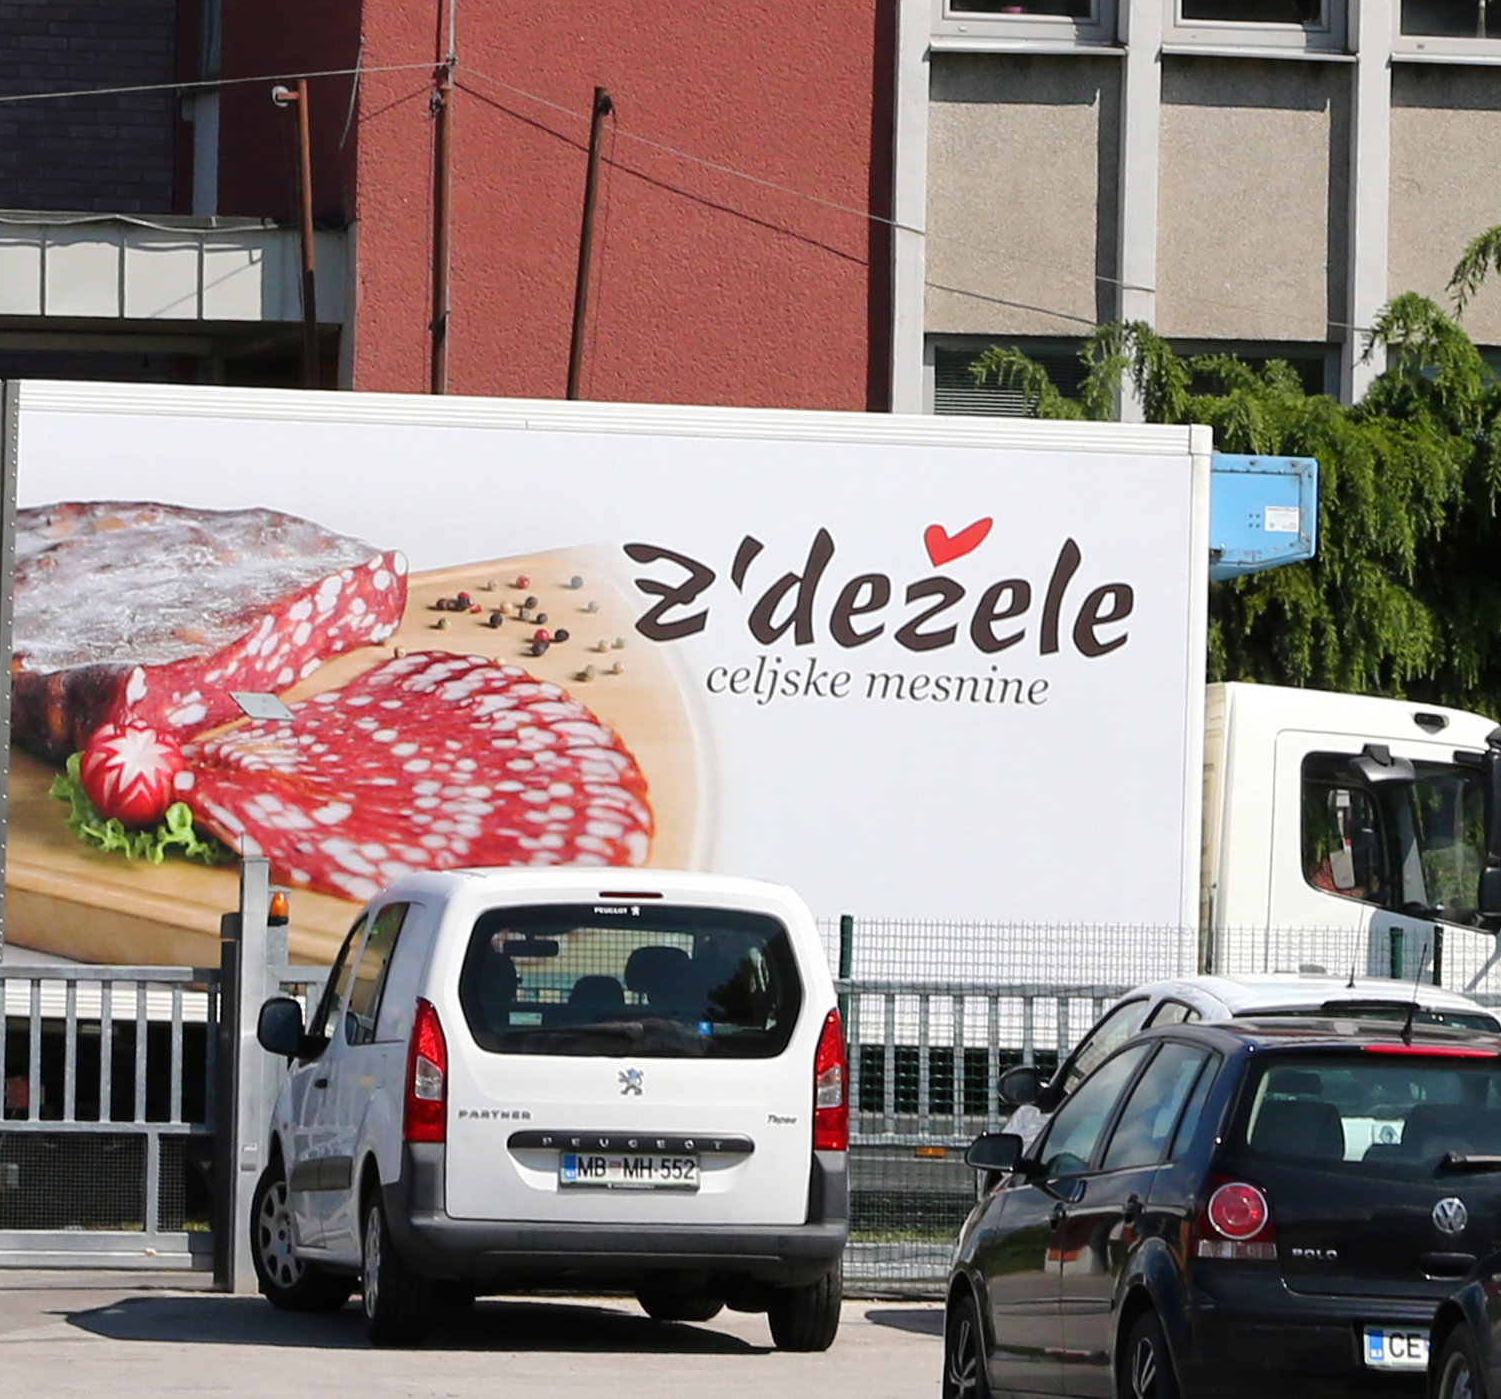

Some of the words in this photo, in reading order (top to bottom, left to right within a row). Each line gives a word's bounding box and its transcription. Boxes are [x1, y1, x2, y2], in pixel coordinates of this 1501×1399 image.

[706, 655, 851, 706] celjske
[865, 665, 1050, 706] mesnine
[458, 1109, 532, 1120] PARTNER
[542, 1136, 724, 1150] PEUGEOT
[577, 1156, 606, 1178] MB
[623, 1157, 696, 1180] MH-552
[1291, 1248, 1338, 1259] POLO
[1389, 1332, 1422, 1359] CE
